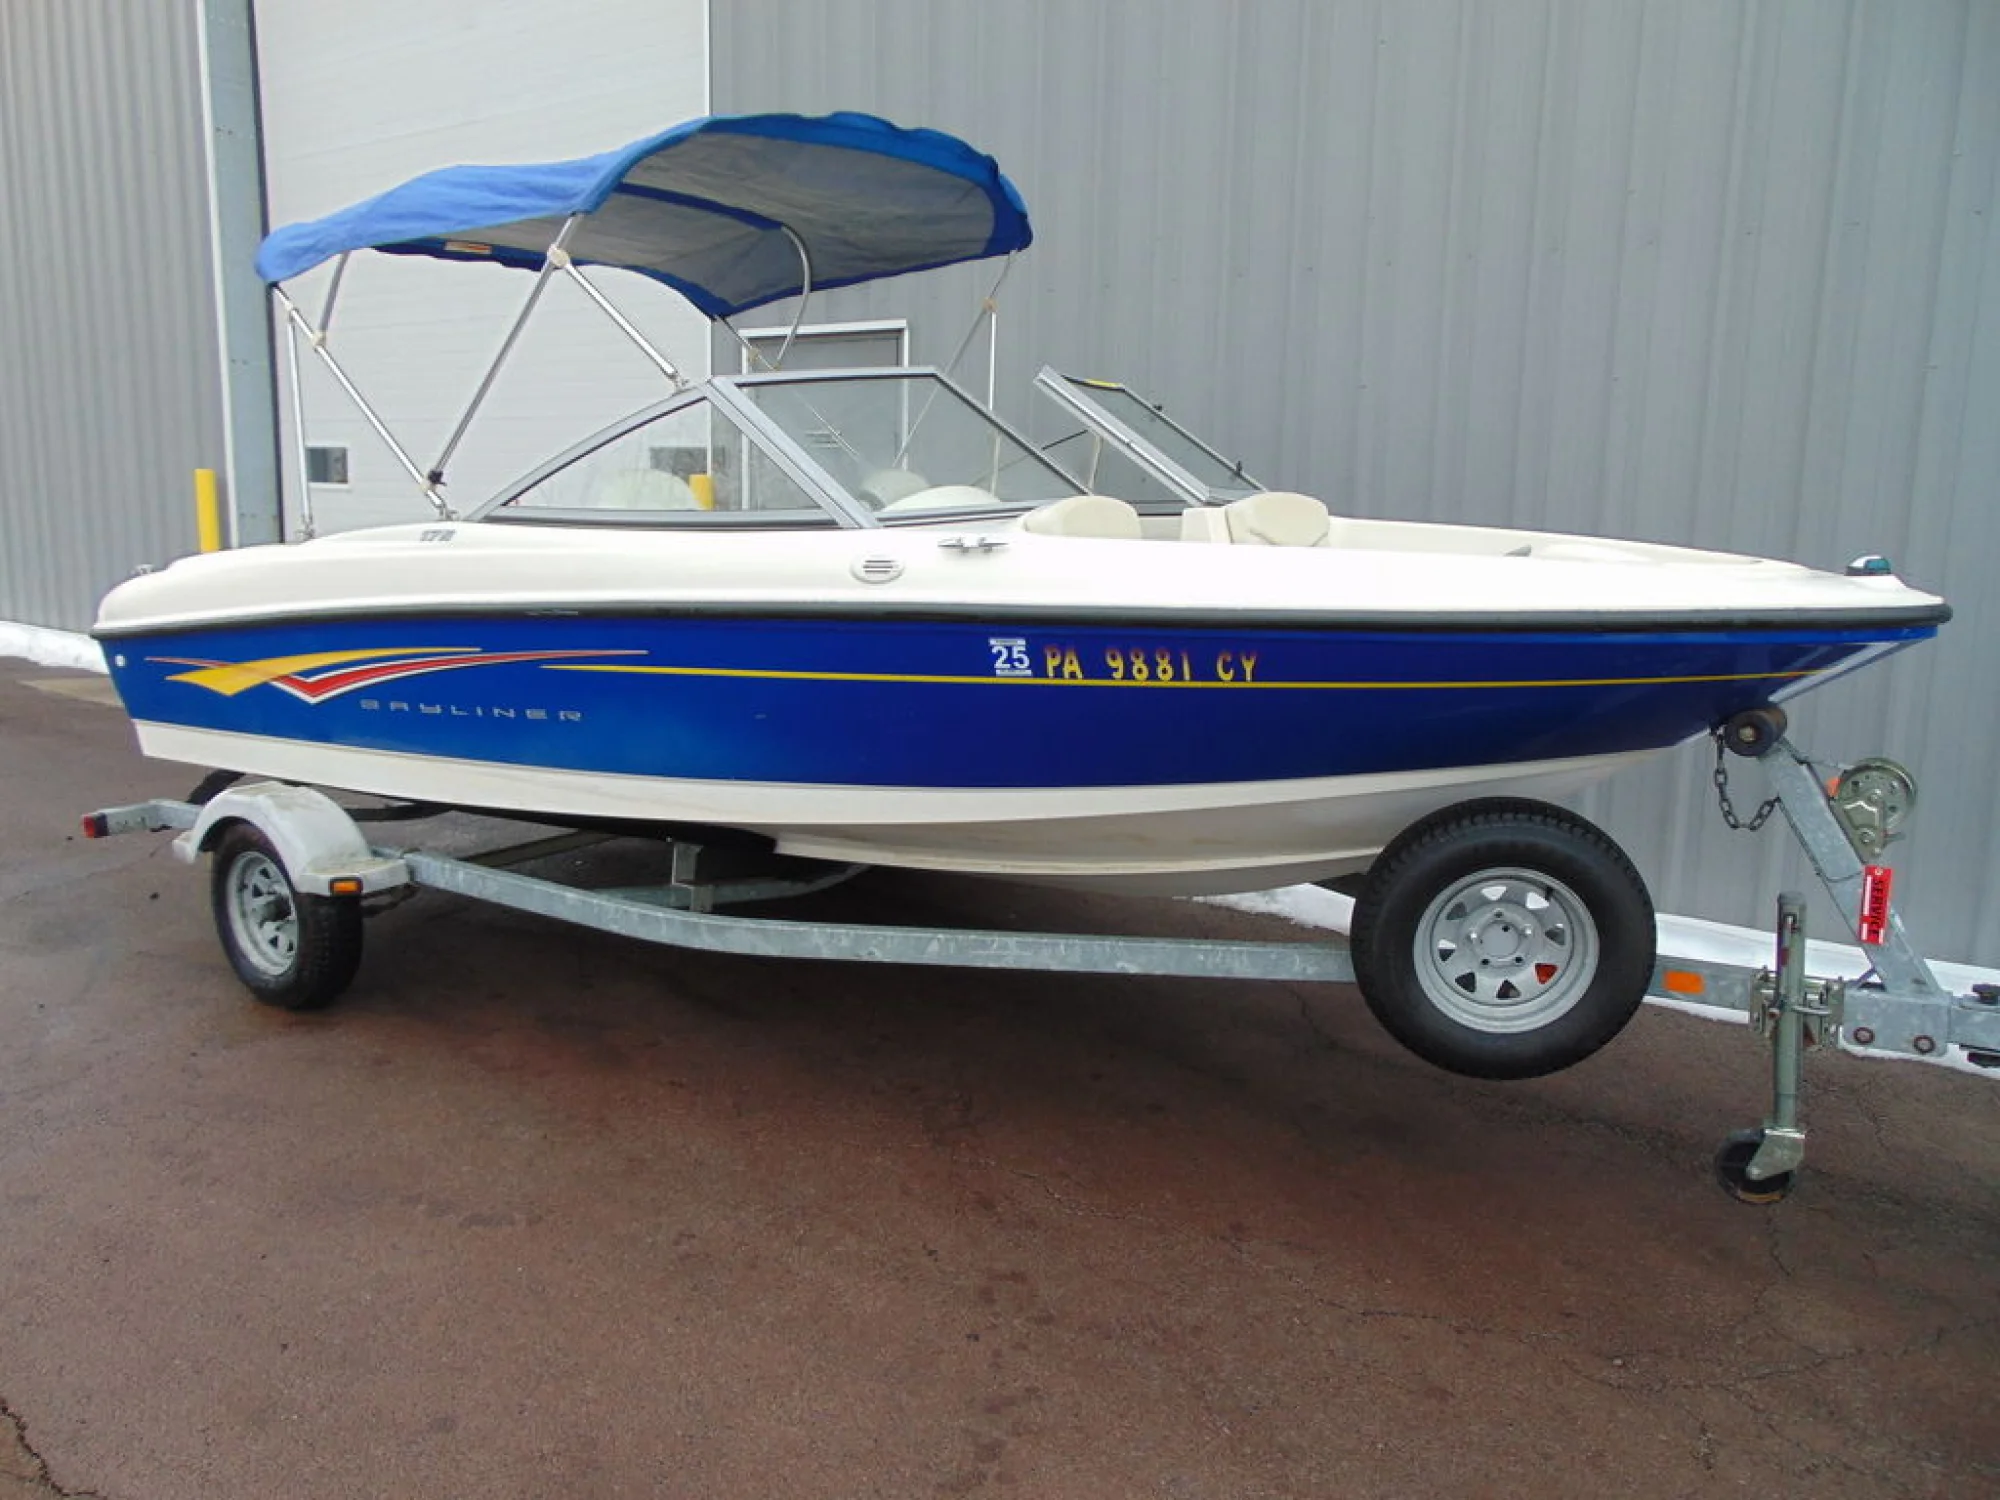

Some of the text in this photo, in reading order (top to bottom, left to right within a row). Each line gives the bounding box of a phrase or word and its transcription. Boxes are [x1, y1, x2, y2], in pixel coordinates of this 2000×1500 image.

[991, 645, 1030, 668] 25
[1045, 645, 1256, 682] PA 9881 CY
[361, 699, 581, 721] BAYLINER
